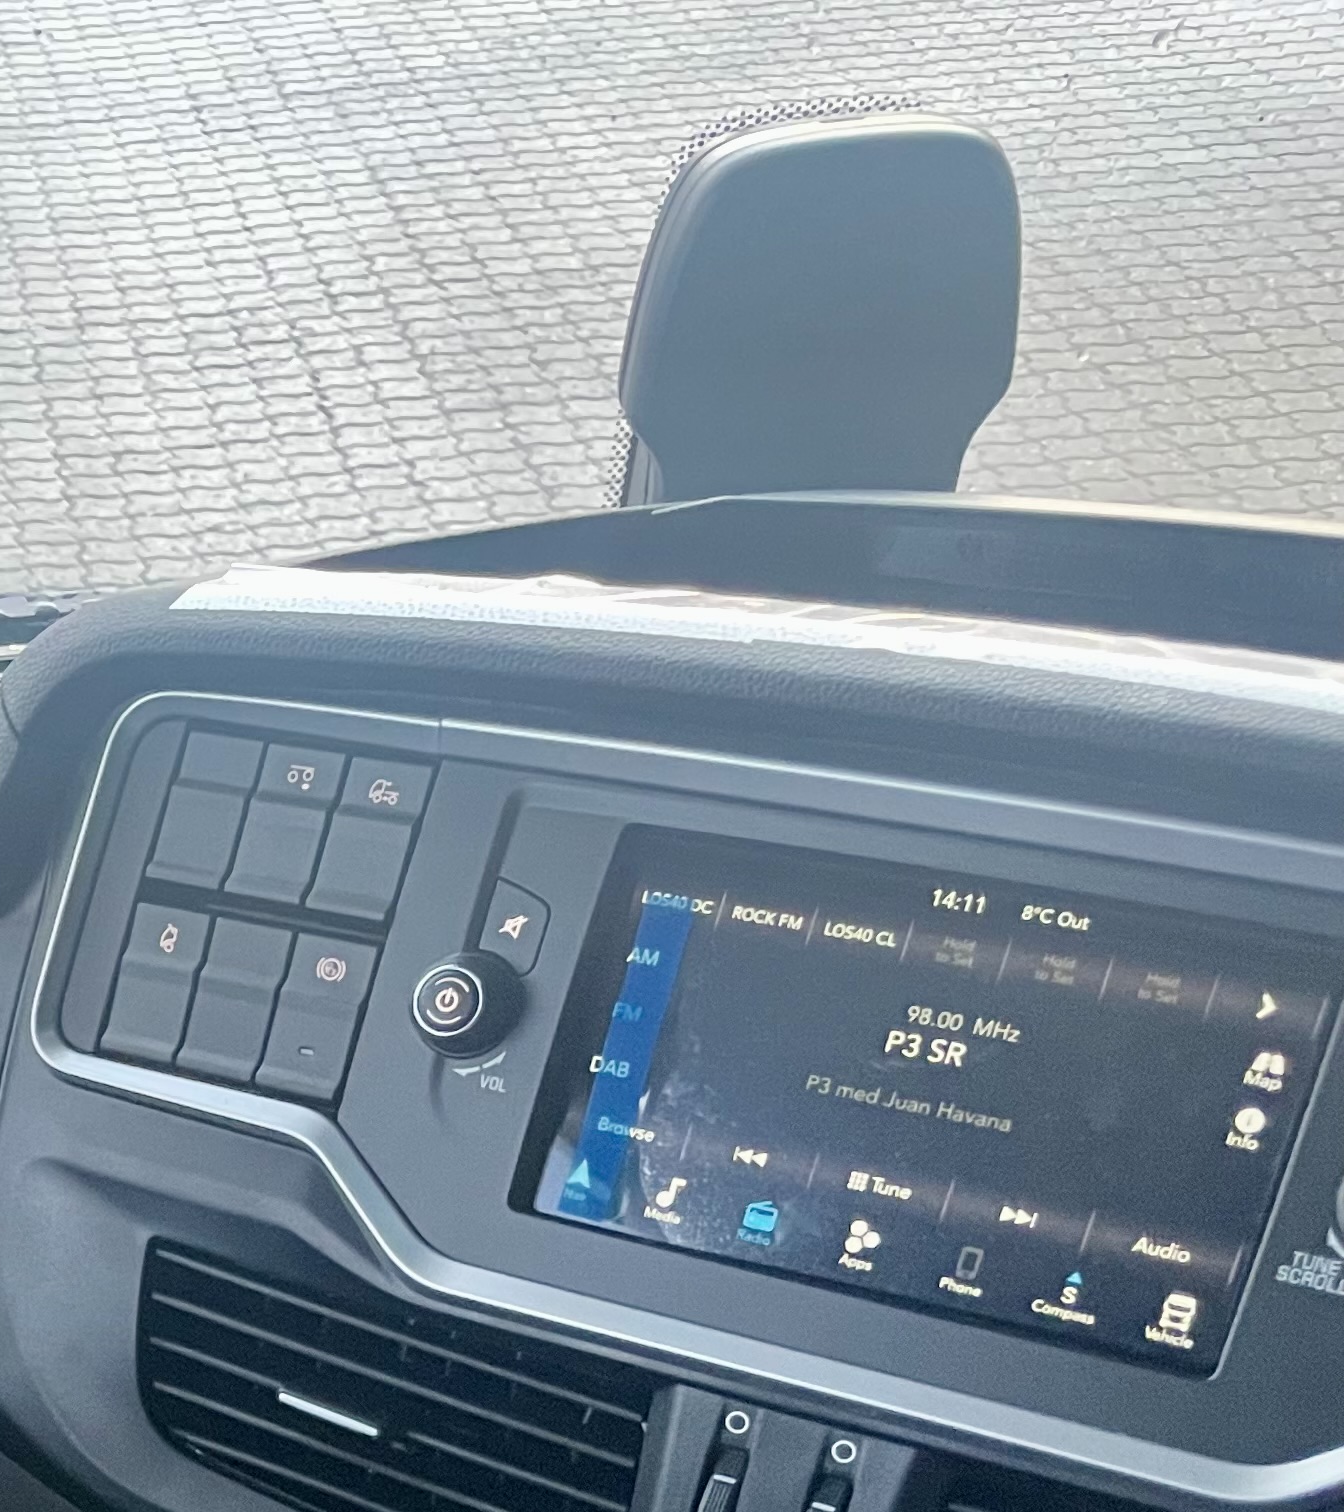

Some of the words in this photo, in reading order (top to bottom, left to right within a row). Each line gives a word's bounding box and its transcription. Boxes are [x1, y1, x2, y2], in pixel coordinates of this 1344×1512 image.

[641, 890, 689, 911] LOS40
[932, 888, 986, 914] 14:11
[732, 905, 776, 927] ROCK
[778, 913, 803, 931] FM
[1021, 904, 1052, 925] 8°C
[1057, 911, 1091, 931] Out
[824, 920, 873, 943] LOS40
[875, 931, 897, 948] CL
[626, 946, 660, 967] AM
[612, 1002, 643, 1022] FM
[907, 1005, 964, 1032] 98.00
[972, 1017, 1020, 1043] MHz
[883, 1029, 923, 1058] P3
[927, 1038, 967, 1067] SR
[589, 1055, 630, 1079] DAB
[480, 1073, 506, 1093] VOL
[1243, 1070, 1283, 1092] Map
[806, 1075, 830, 1094] P3
[836, 1081, 881, 1105] med
[882, 1087, 931, 1115] Juan
[937, 1101, 1013, 1133] Havana
[597, 1116, 655, 1144] Browse
[1225, 1131, 1260, 1152] Info
[871, 1177, 913, 1201] Tune
[644, 1205, 682, 1225] Media
[736, 1228, 771, 1246] Radio
[838, 1252, 873, 1271] Apps
[1131, 1236, 1191, 1263] Audio
[1292, 1250, 1343, 1276] TUNE
[939, 1276, 983, 1298] Phone
[1060, 1286, 1078, 1304] S
[1031, 1298, 1096, 1326] Compass
[1145, 1325, 1194, 1350] Vehicle
